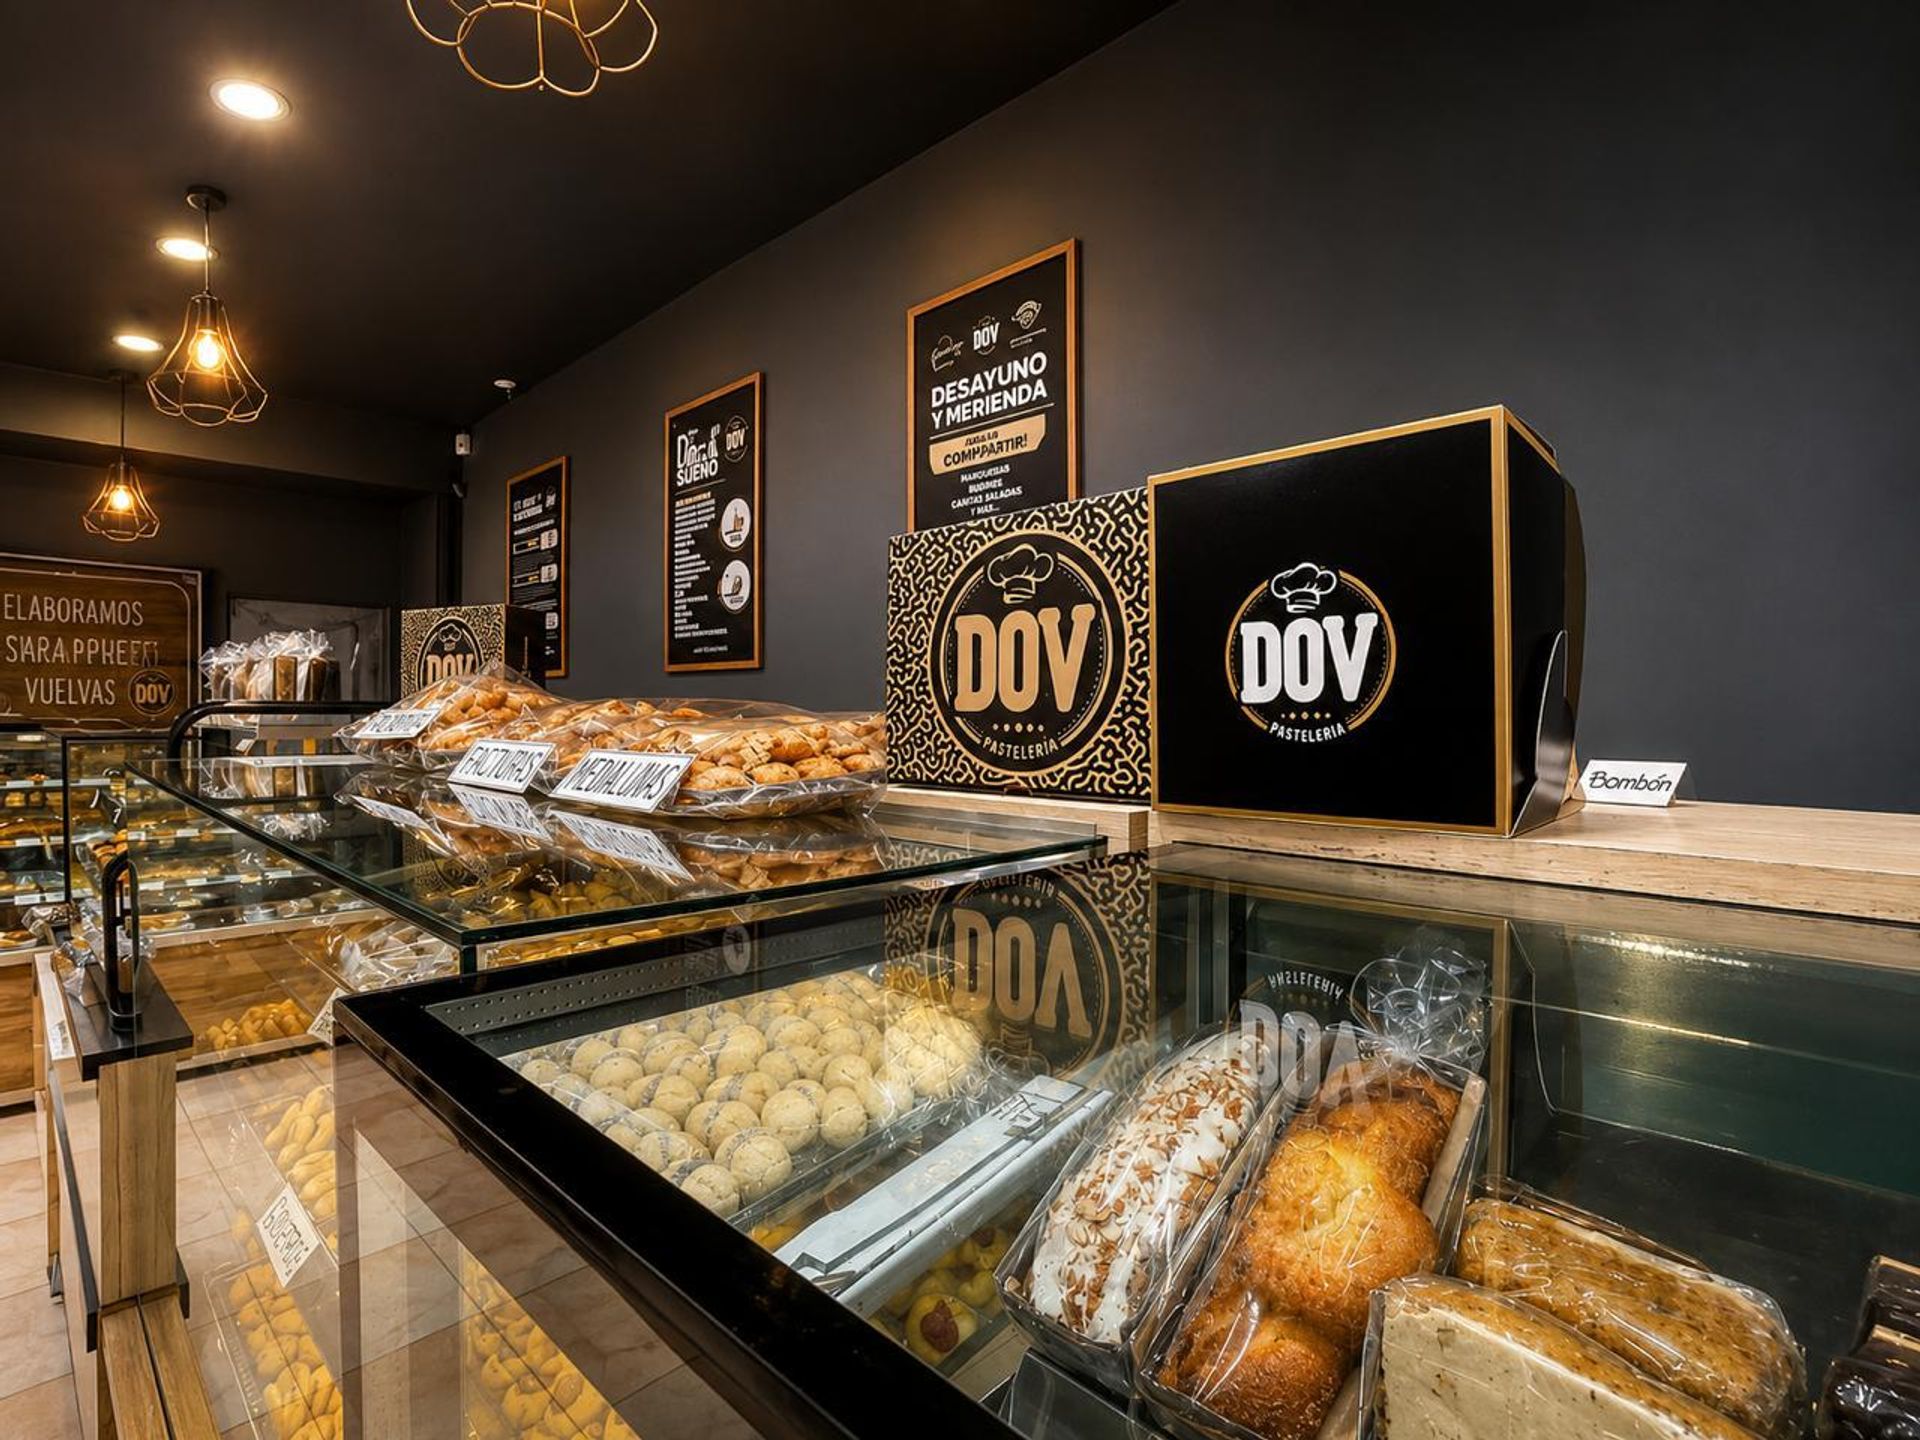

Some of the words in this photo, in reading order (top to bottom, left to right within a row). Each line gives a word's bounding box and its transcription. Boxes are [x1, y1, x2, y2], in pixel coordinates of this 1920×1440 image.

[973, 322, 1000, 351] DOV
[931, 351, 1048, 409] DESAYUNO
[931, 411, 945, 430] Y
[946, 378, 1048, 427] MERIENDA
[3, 594, 144, 627] ELABORAMOS
[954, 603, 1097, 713] DOV
[1240, 612, 1379, 704] DOV
[24, 677, 116, 705] VUELVAS
[1269, 721, 1346, 743] PASTELERIA
[459, 746, 543, 783] FACTURAS
[564, 757, 681, 799] MEDIALUNAS
[1589, 770, 1673, 792] Bombón
